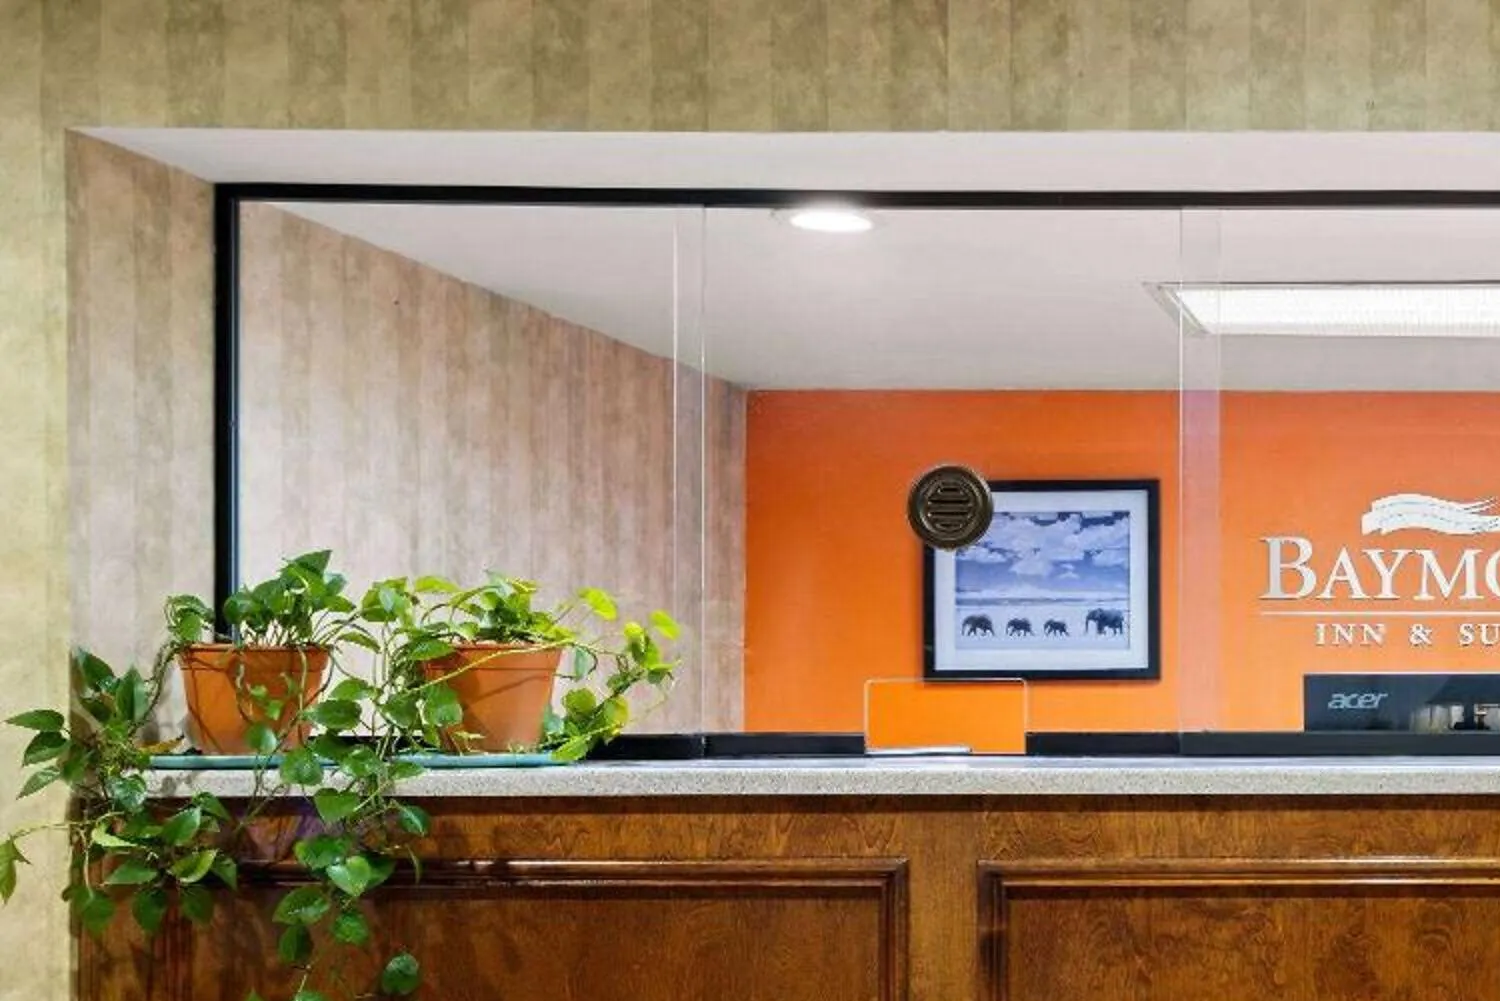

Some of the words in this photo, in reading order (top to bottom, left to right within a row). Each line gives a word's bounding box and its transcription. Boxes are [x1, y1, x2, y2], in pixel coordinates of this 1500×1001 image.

[1315, 623, 1386, 646] INN
[1409, 623, 1433, 645] &
[1327, 691, 1389, 710] acer
